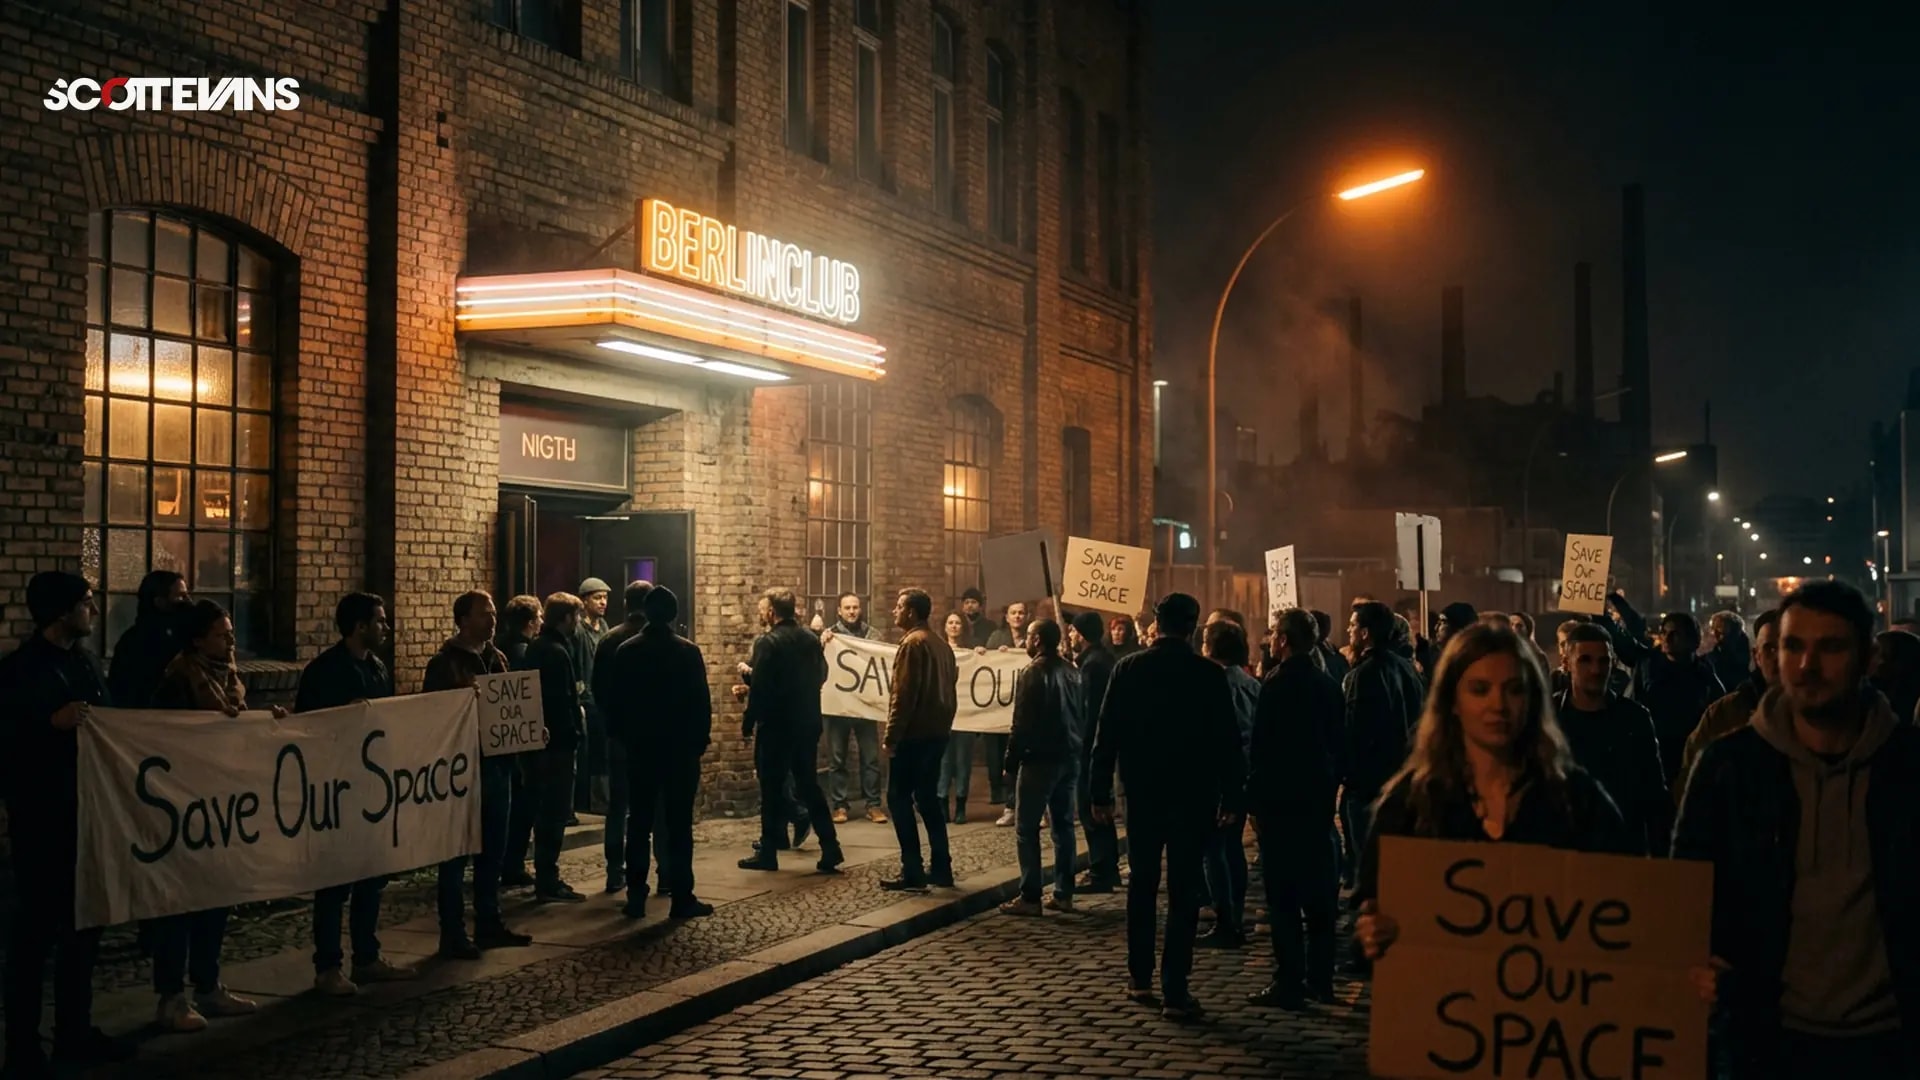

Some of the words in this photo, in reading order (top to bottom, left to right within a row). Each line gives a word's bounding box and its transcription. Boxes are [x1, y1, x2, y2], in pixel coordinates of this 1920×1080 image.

[650, 199, 861, 323] BERLINCLUB
[1081, 548, 1126, 570] SAVE
[1570, 541, 1603, 563] SAVE
[1077, 580, 1130, 604] SPACE
[486, 676, 532, 704] SAVE
[835, 649, 892, 697] SAV
[970, 666, 1020, 708] OU
[489, 720, 539, 748] SPACE
[131, 756, 259, 863] Save
[272, 743, 352, 838] Our
[360, 729, 469, 848] Space
[1435, 858, 1632, 950] Save
[1496, 944, 1614, 1006] Our
